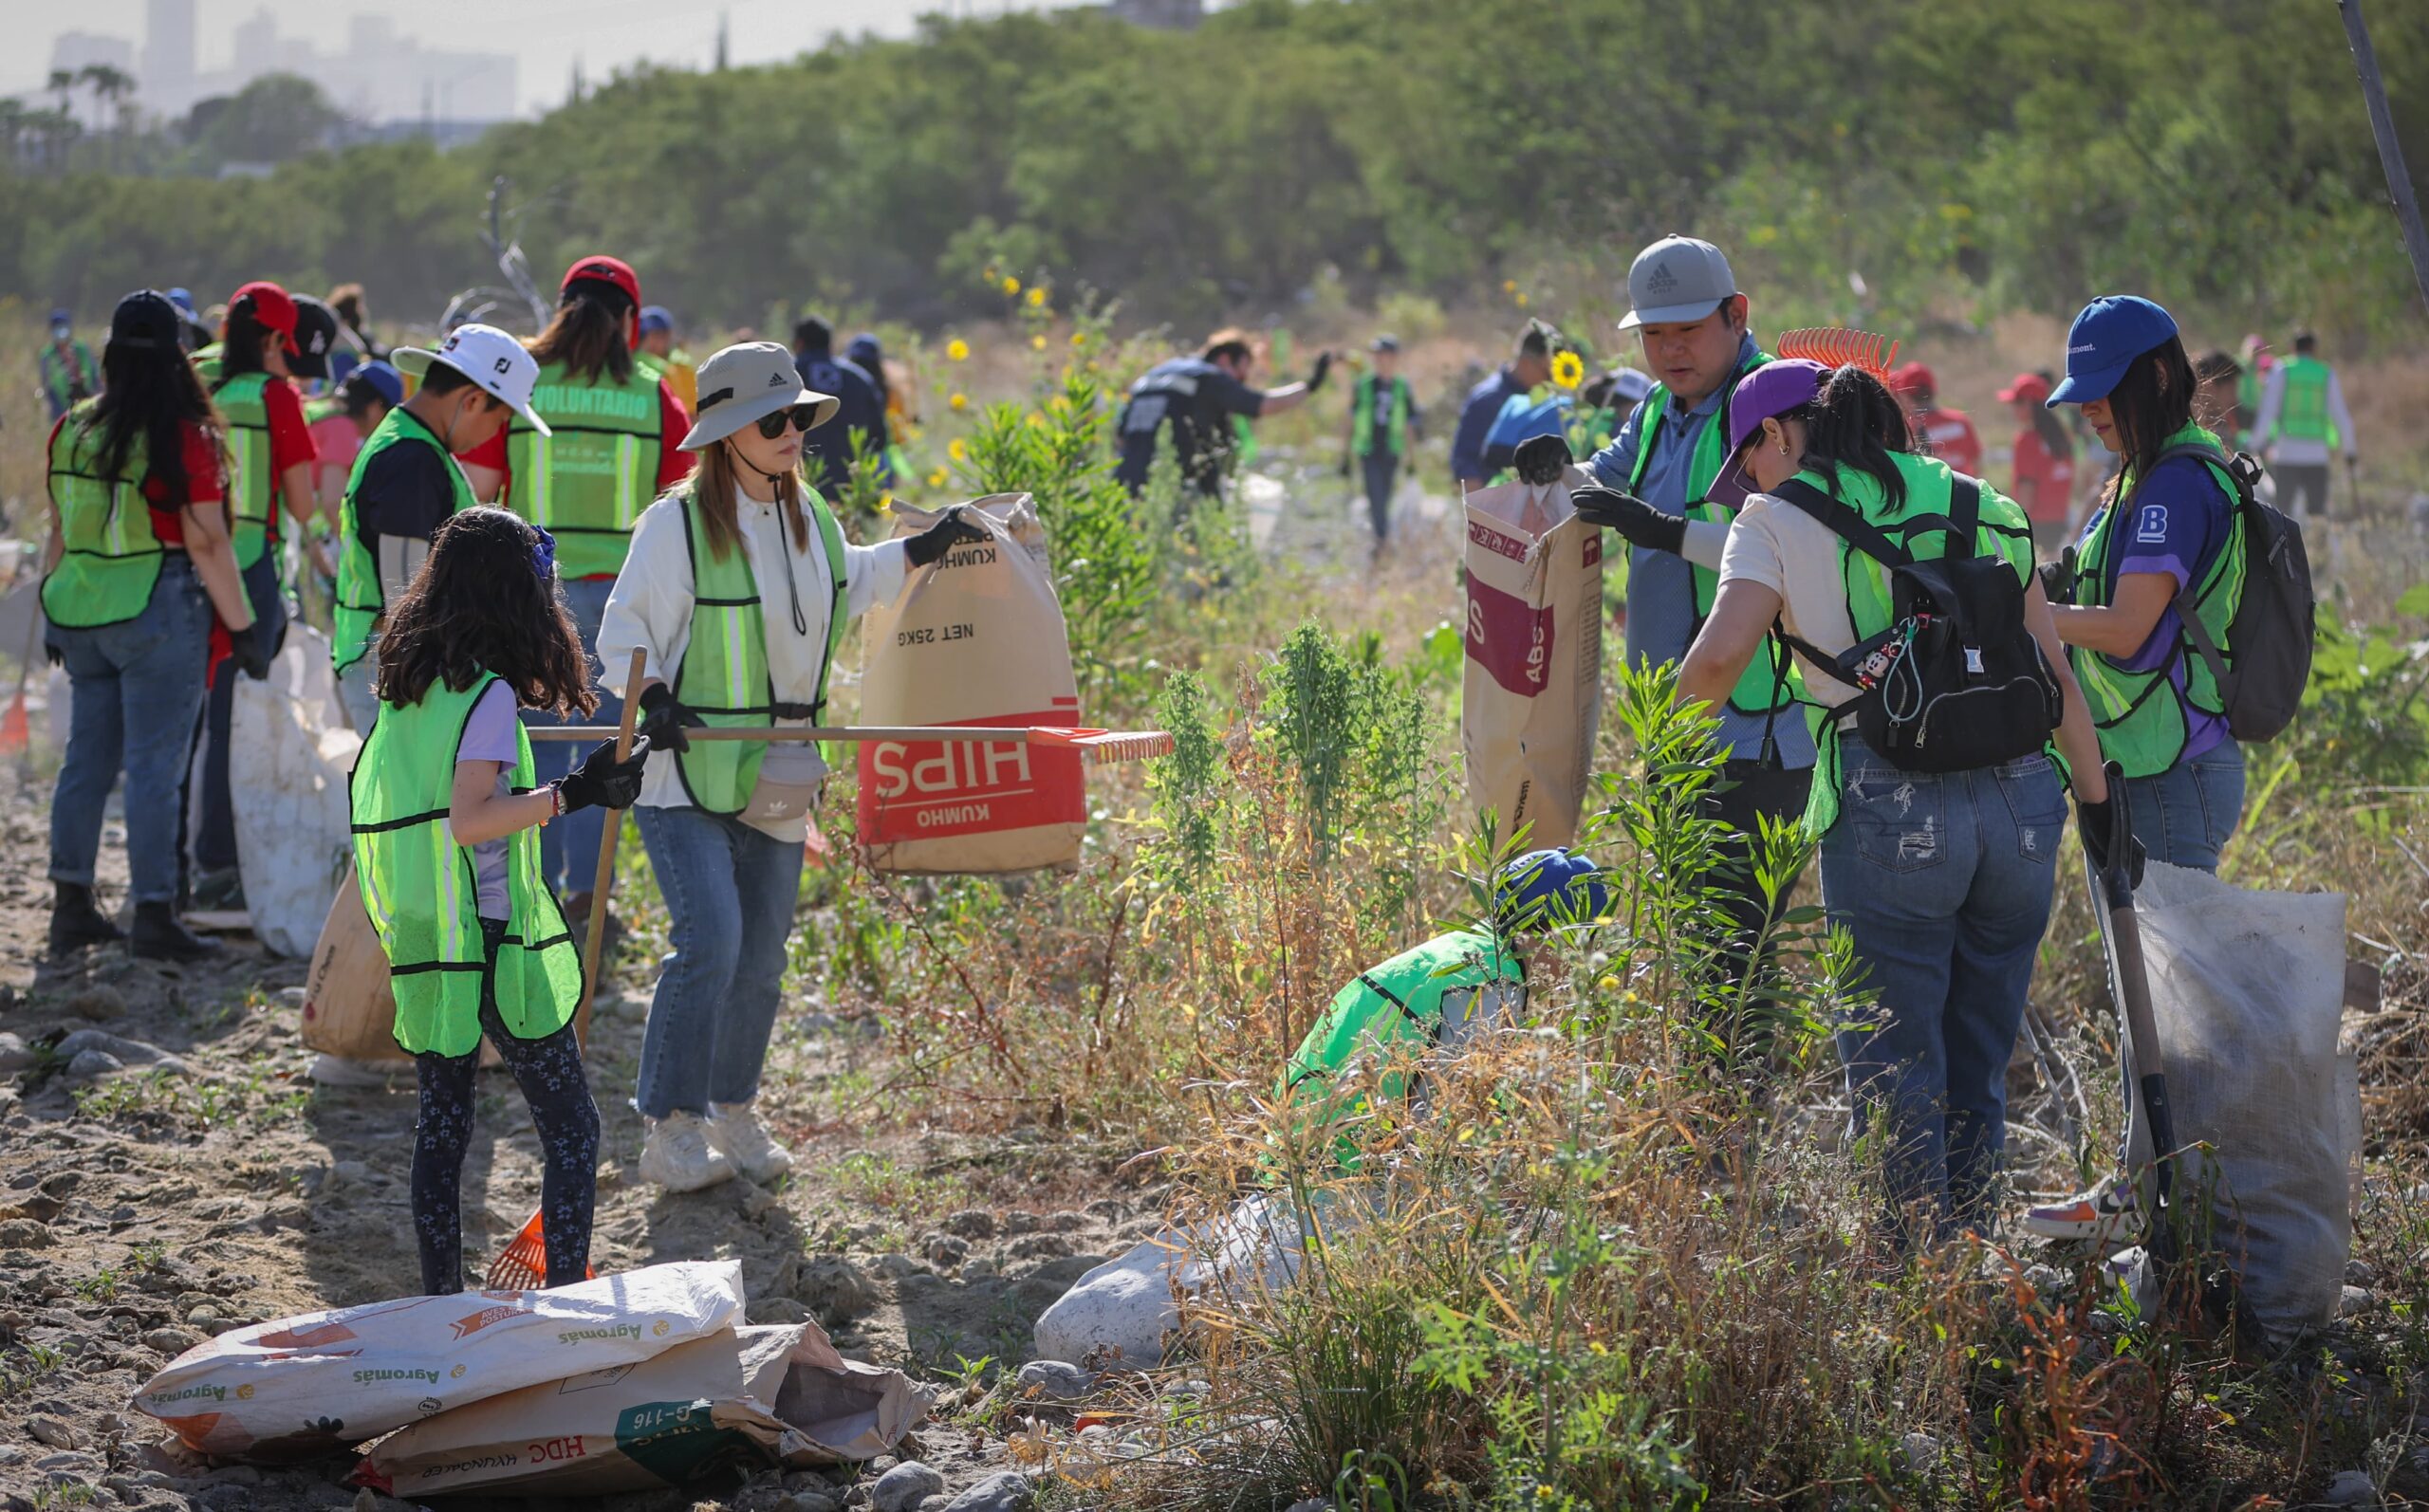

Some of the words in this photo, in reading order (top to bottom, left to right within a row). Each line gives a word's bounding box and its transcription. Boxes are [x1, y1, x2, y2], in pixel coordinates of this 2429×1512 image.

[493, 357, 512, 375] FJ
[898, 628, 935, 647] 25KG
[941, 623, 973, 641] NET
[873, 740, 1032, 798] HIPS
[917, 803, 991, 828] KUMHO
[558, 1323, 642, 1347] Agromás
[352, 1369, 440, 1386] Agromás
[528, 1434, 585, 1464] HDC
